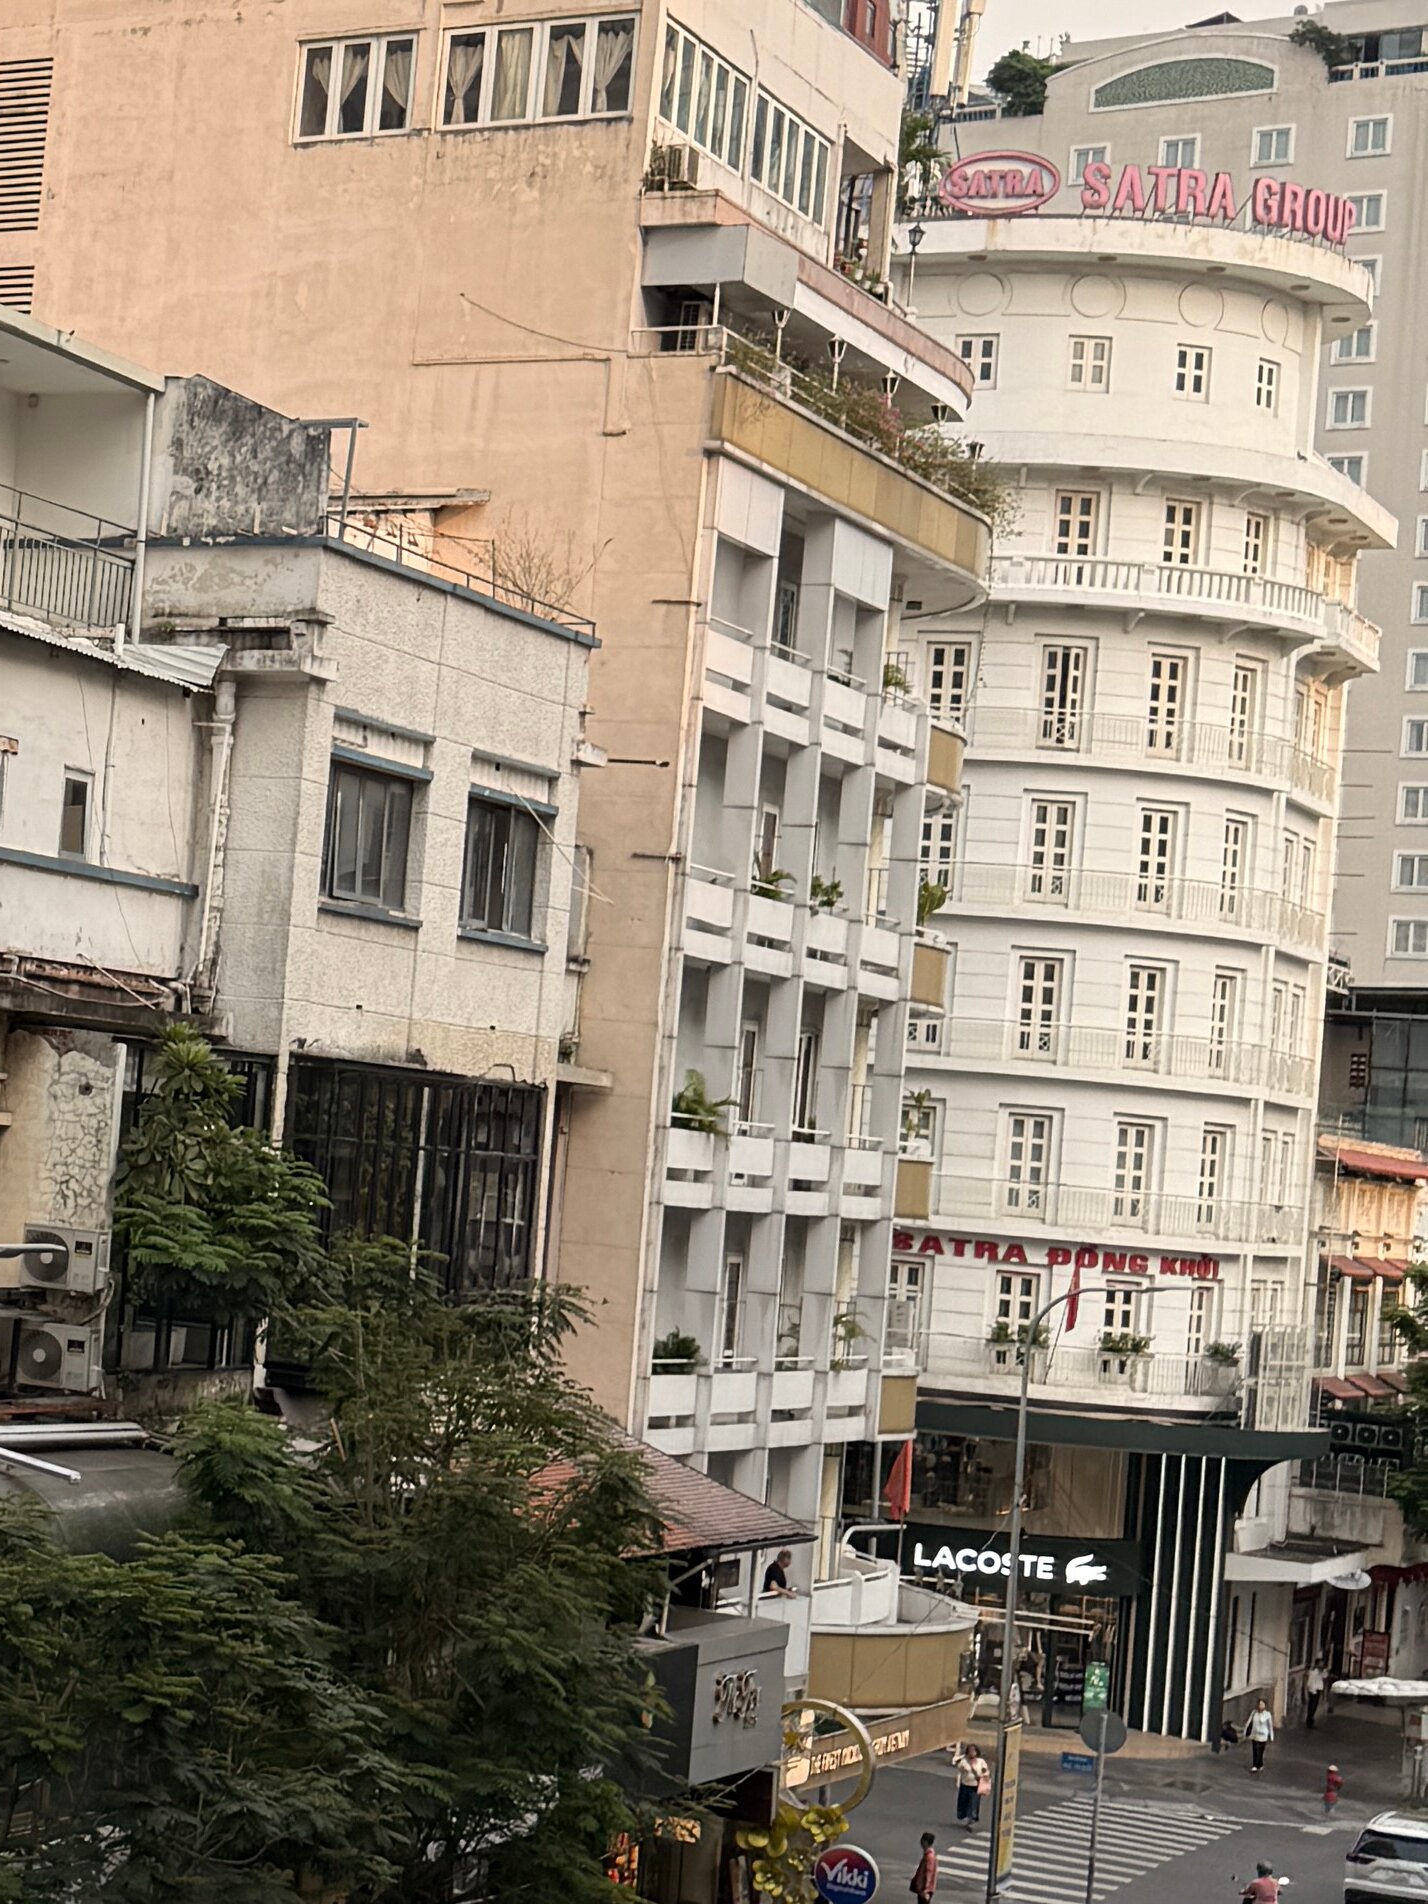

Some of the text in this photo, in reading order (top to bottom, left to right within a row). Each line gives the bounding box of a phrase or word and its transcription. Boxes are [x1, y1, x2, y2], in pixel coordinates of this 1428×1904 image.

[949, 168, 1043, 197] SATRA
[1082, 162, 1357, 245] SATRA GROUP
[913, 1542, 1054, 1580] LACOSTE
[820, 1857, 870, 1889] Vikki
